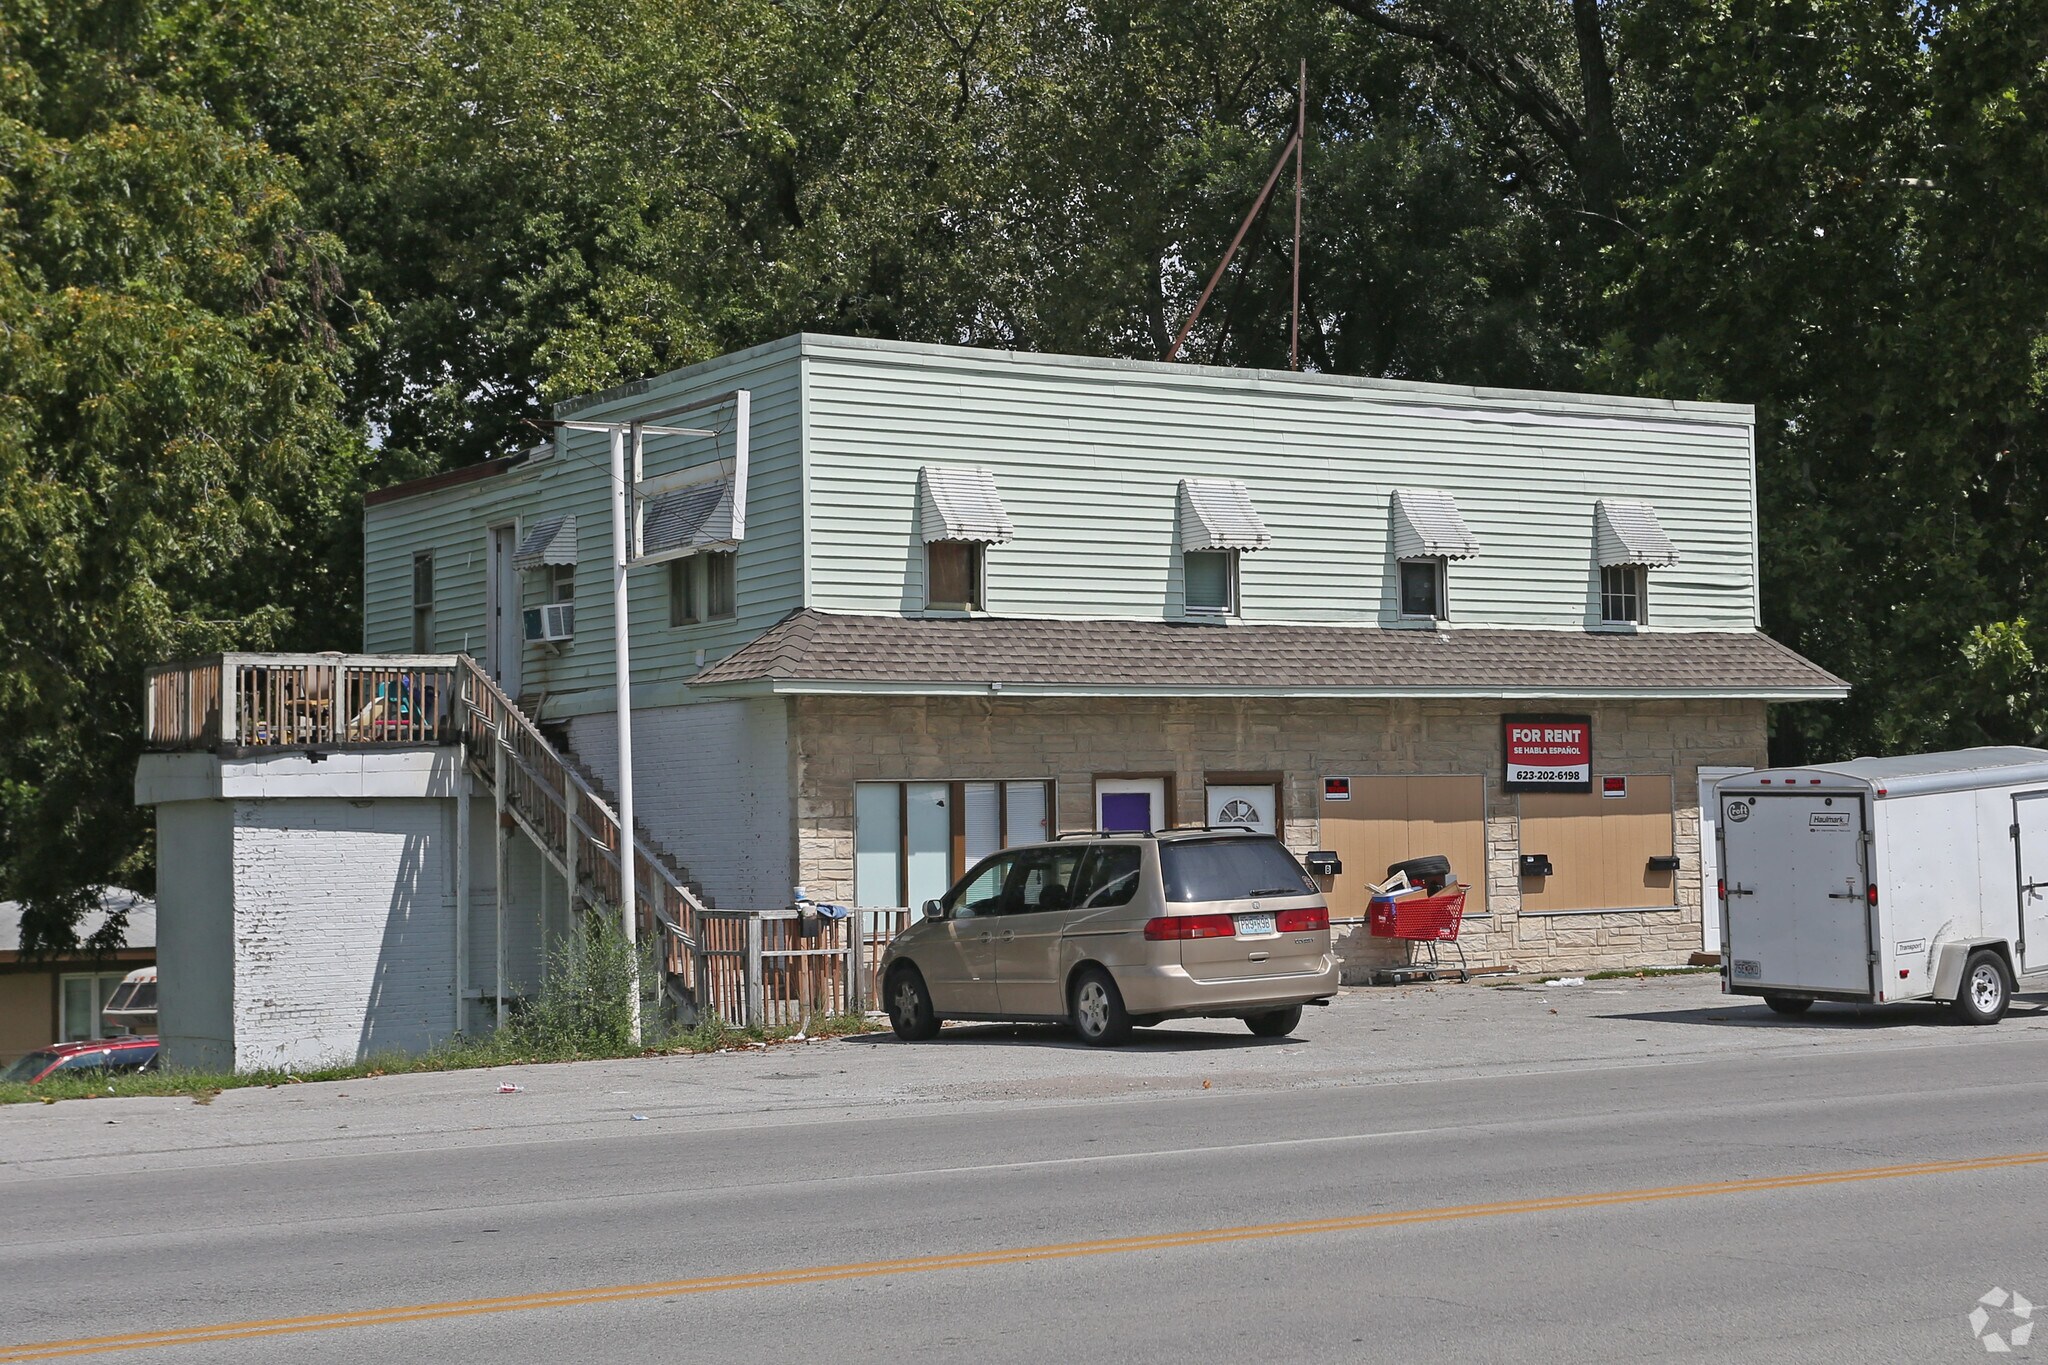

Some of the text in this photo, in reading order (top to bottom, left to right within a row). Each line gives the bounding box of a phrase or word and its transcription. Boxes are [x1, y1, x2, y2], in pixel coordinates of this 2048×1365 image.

[1512, 728, 1581, 743] FOR RENT
[1513, 746, 1523, 754] SE
[1549, 745, 1581, 755] ESPAÑOL
[1516, 770, 1580, 780] 623-202-6198
[1813, 815, 1844, 823] Haulmark
[1899, 942, 1922, 951] Transport
